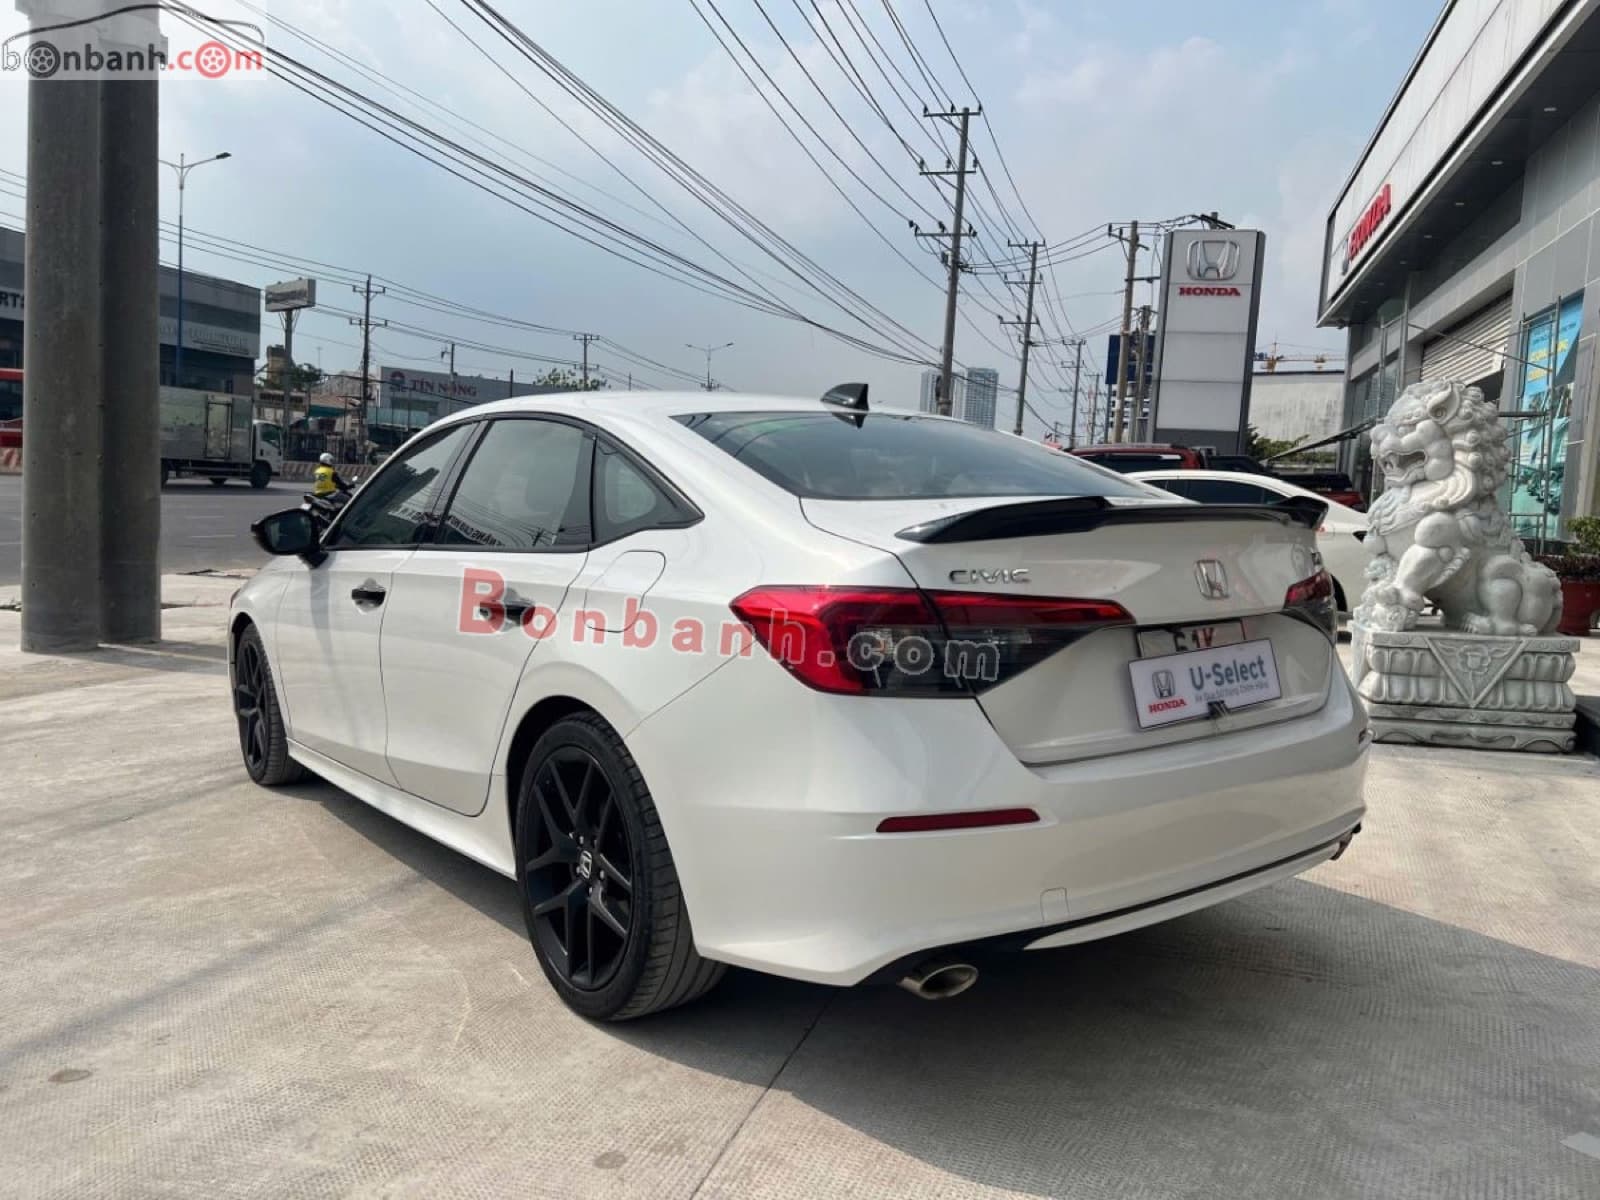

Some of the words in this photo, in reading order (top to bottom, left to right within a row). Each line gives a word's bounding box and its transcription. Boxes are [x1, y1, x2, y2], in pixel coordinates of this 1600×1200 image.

[1179, 286, 1241, 297] HONDA
[949, 568, 1030, 585] CIVIC
[1188, 655, 1267, 690] U-Select
[1148, 698, 1187, 713] HONDA
